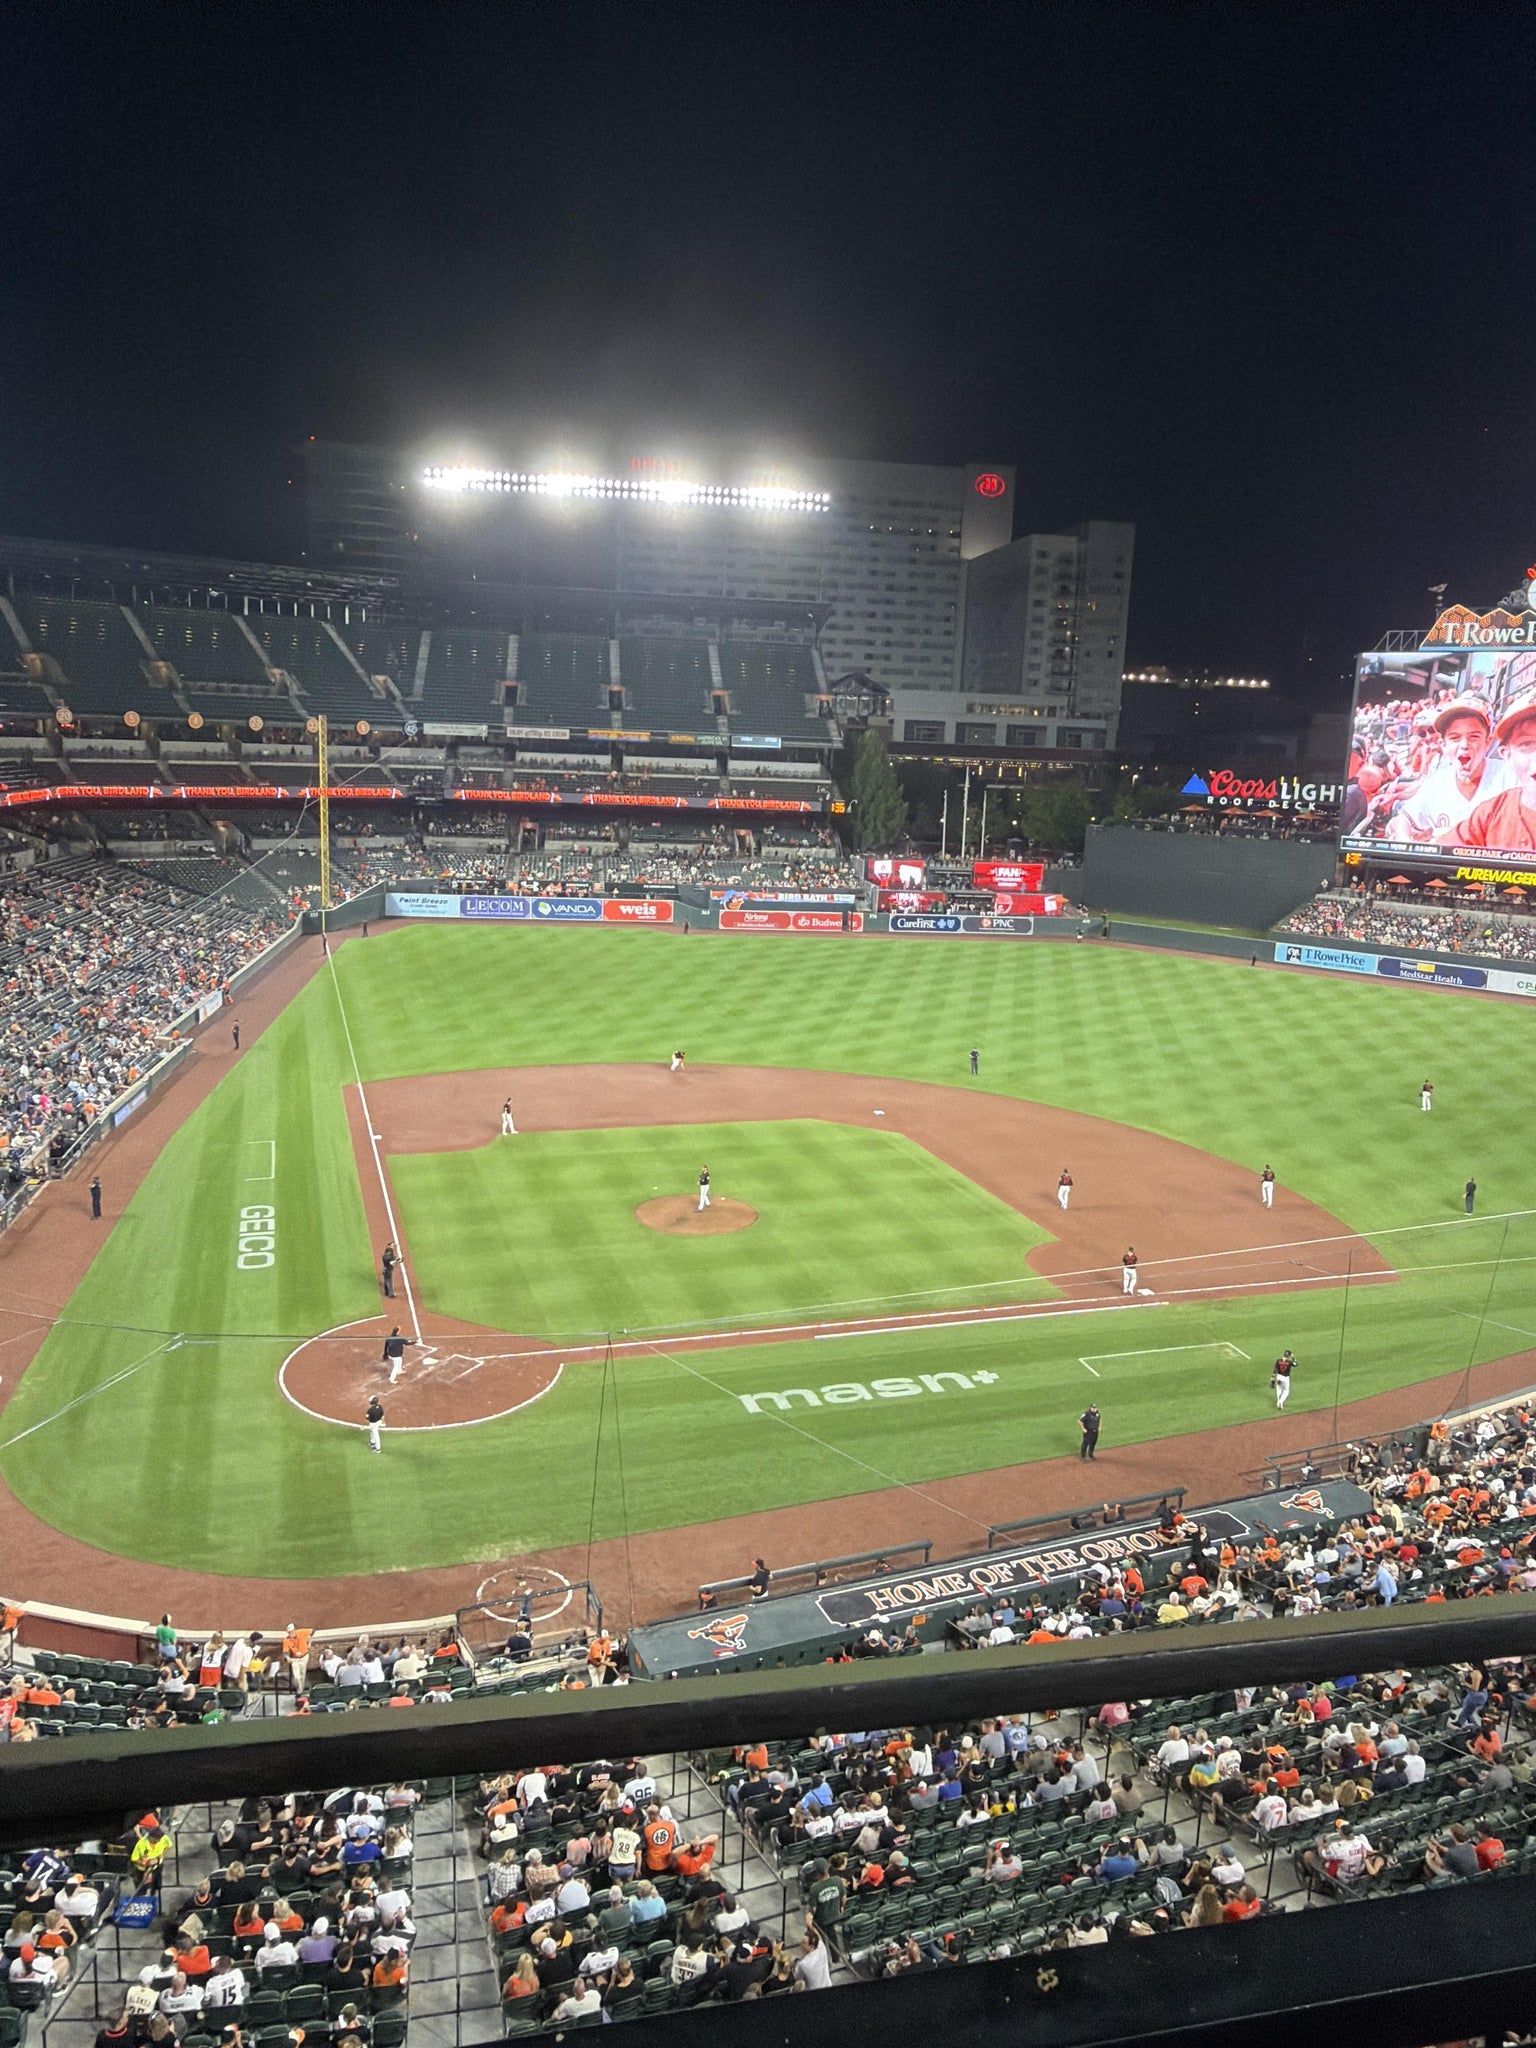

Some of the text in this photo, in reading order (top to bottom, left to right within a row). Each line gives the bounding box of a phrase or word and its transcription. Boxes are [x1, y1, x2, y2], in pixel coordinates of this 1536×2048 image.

[1463, 622, 1526, 645] Rowe
[1209, 770, 1278, 800] Coors
[103, 786, 150, 797] BIRDLAND
[184, 786, 214, 797] THANK
[237, 787, 278, 797] BIRDLAND
[310, 788, 336, 797] THANK
[355, 788, 392, 798] BIRDLAND
[465, 789, 492, 800] THANK
[511, 790, 550, 801] BIRDLAND
[593, 794, 622, 804] THANK
[638, 795, 677, 806] BIRDLAND
[718, 798, 743, 809] THANK
[762, 800, 800, 811] BIRDLAND
[1206, 795, 1316, 811] ROOF DECK
[1452, 848, 1480, 858] ORIOLE
[1480, 850, 1502, 860] PARK
[998, 867, 1020, 877] FAN
[777, 892, 801, 902] BIRD
[801, 894, 828, 902] BATH
[466, 900, 524, 912] LECOM
[551, 904, 597, 914] VANDA
[618, 902, 657, 915] weis
[744, 912, 768, 922] Airtemp
[812, 918, 858, 928] Budweir
[992, 918, 1015, 928] PNC
[896, 918, 936, 929] CareFirst
[1314, 950, 1341, 962] Rowe
[1341, 953, 1366, 966] Price
[1400, 970, 1463, 986] MedStar Health
[236, 1204, 276, 1270] GEICO
[864, 1521, 1199, 1611] HOME OF THE ORIOLS
[1275, 1810, 1284, 1825] 7
[618, 1842, 631, 1854] 29
[221, 1986, 238, 2005] 15
